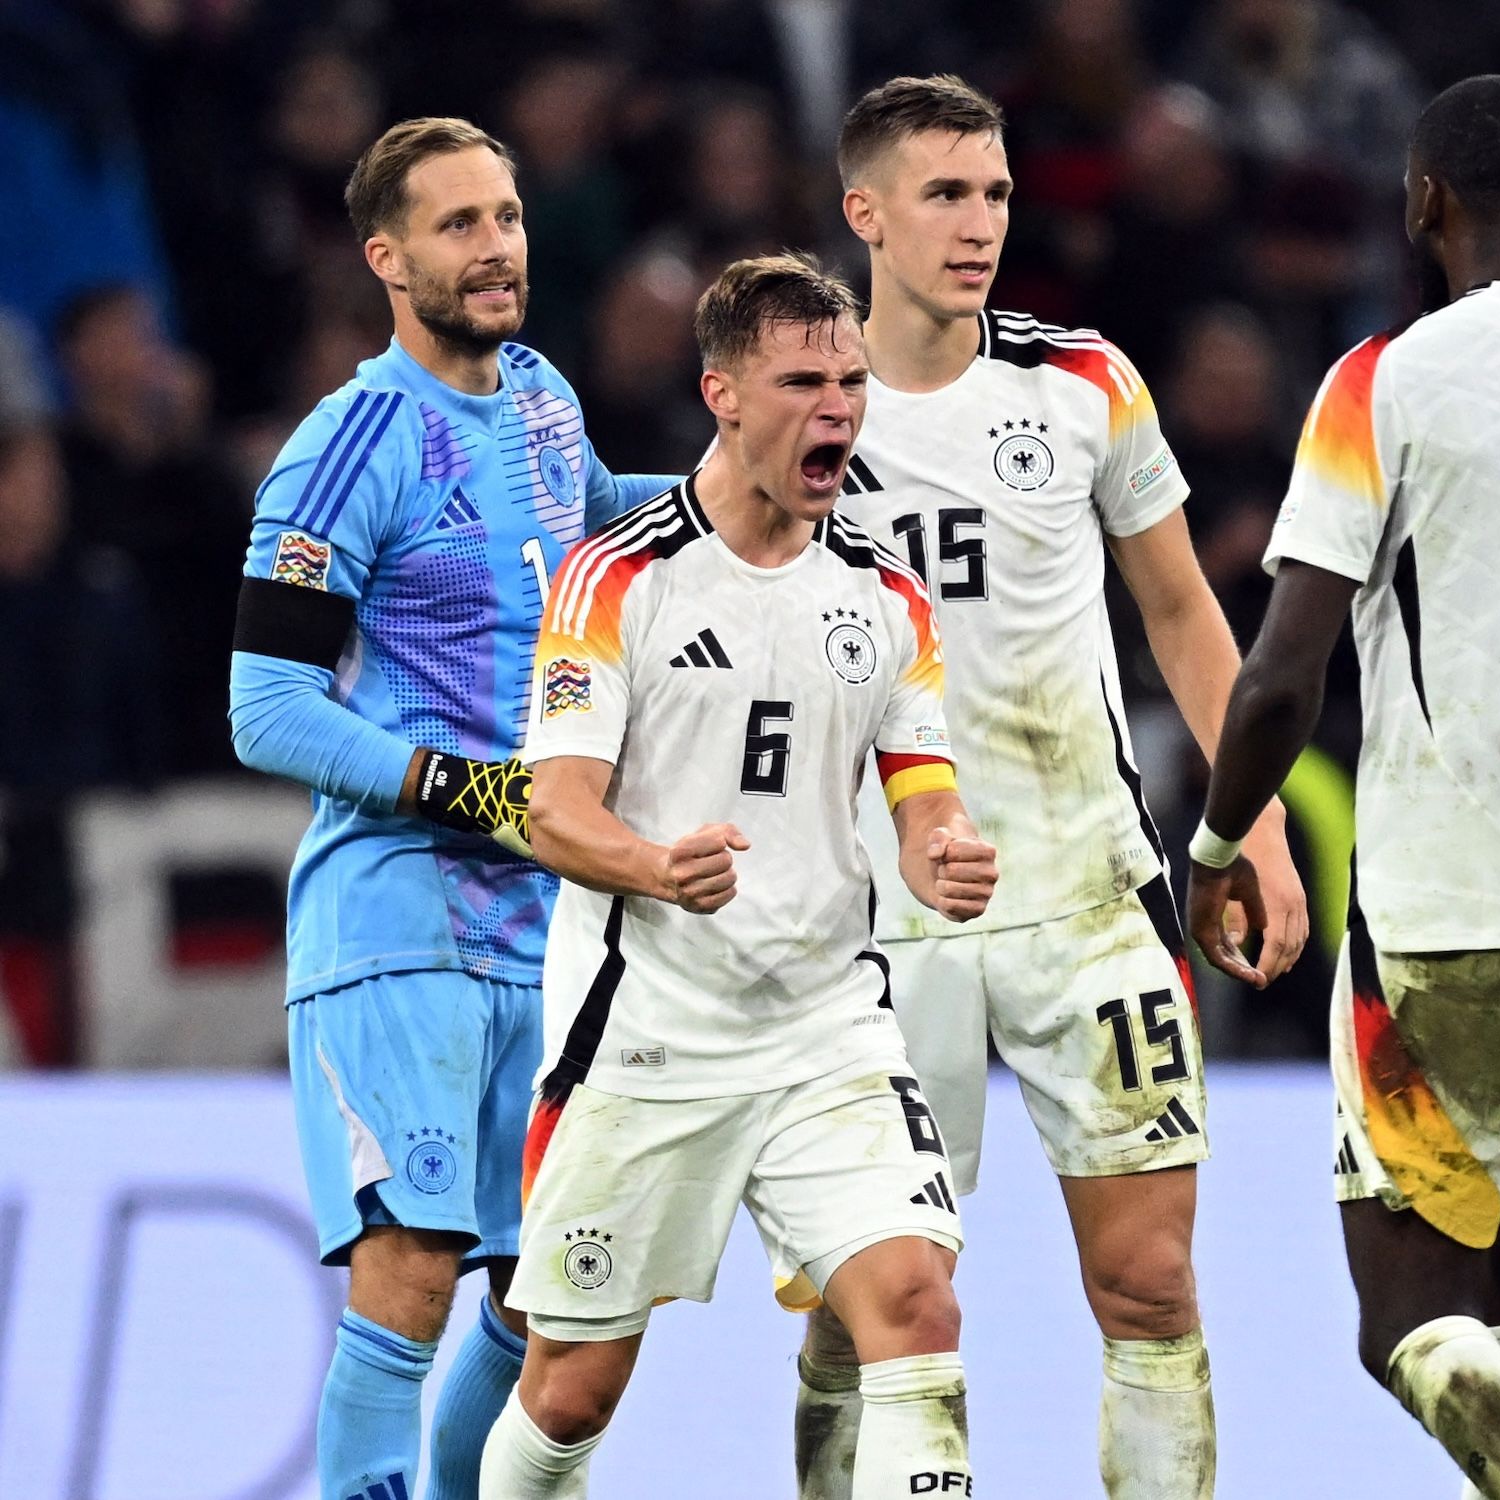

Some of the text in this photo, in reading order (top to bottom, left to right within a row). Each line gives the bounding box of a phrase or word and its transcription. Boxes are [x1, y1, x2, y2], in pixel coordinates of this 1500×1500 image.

[892, 508, 989, 602] 15
[421, 754, 444, 801] Baumann
[740, 699, 793, 798] 6
[1096, 988, 1192, 1093] 15
[888, 1076, 947, 1162] 6
